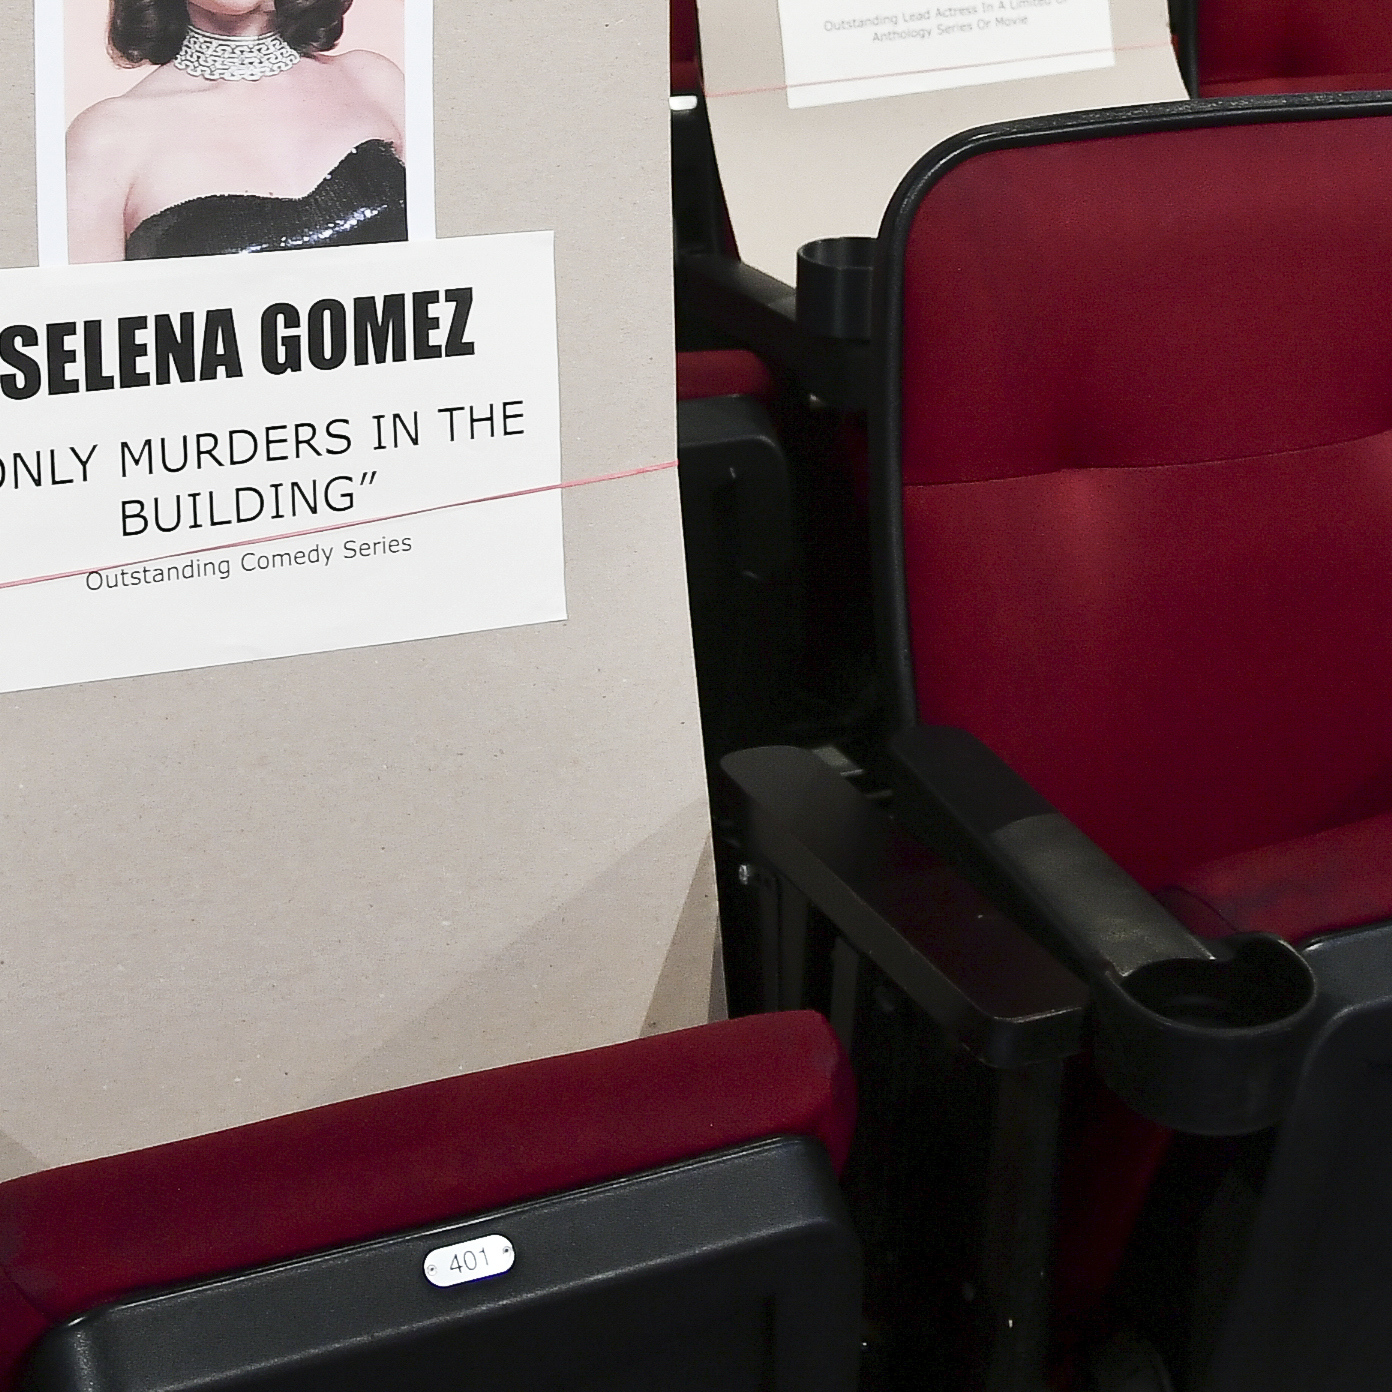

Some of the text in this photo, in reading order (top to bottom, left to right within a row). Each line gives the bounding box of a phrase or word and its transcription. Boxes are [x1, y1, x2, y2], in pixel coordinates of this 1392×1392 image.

[824, 14, 897, 32] Outstanding
[902, 10, 930, 24] Lead
[935, 4, 978, 20] Actress
[872, 26, 933, 43] Anthology
[937, 21, 972, 35] Series
[995, 15, 1028, 27] Movie
[260, 287, 475, 375] GOMEZ
[119, 417, 353, 479] MURDERS
[373, 411, 419, 450] IN
[439, 400, 526, 443] THE
[120, 470, 377, 537] BUILDING”
[85, 534, 413, 592] Outstanding Comedy Series
[450, 1247, 489, 1273] 401
